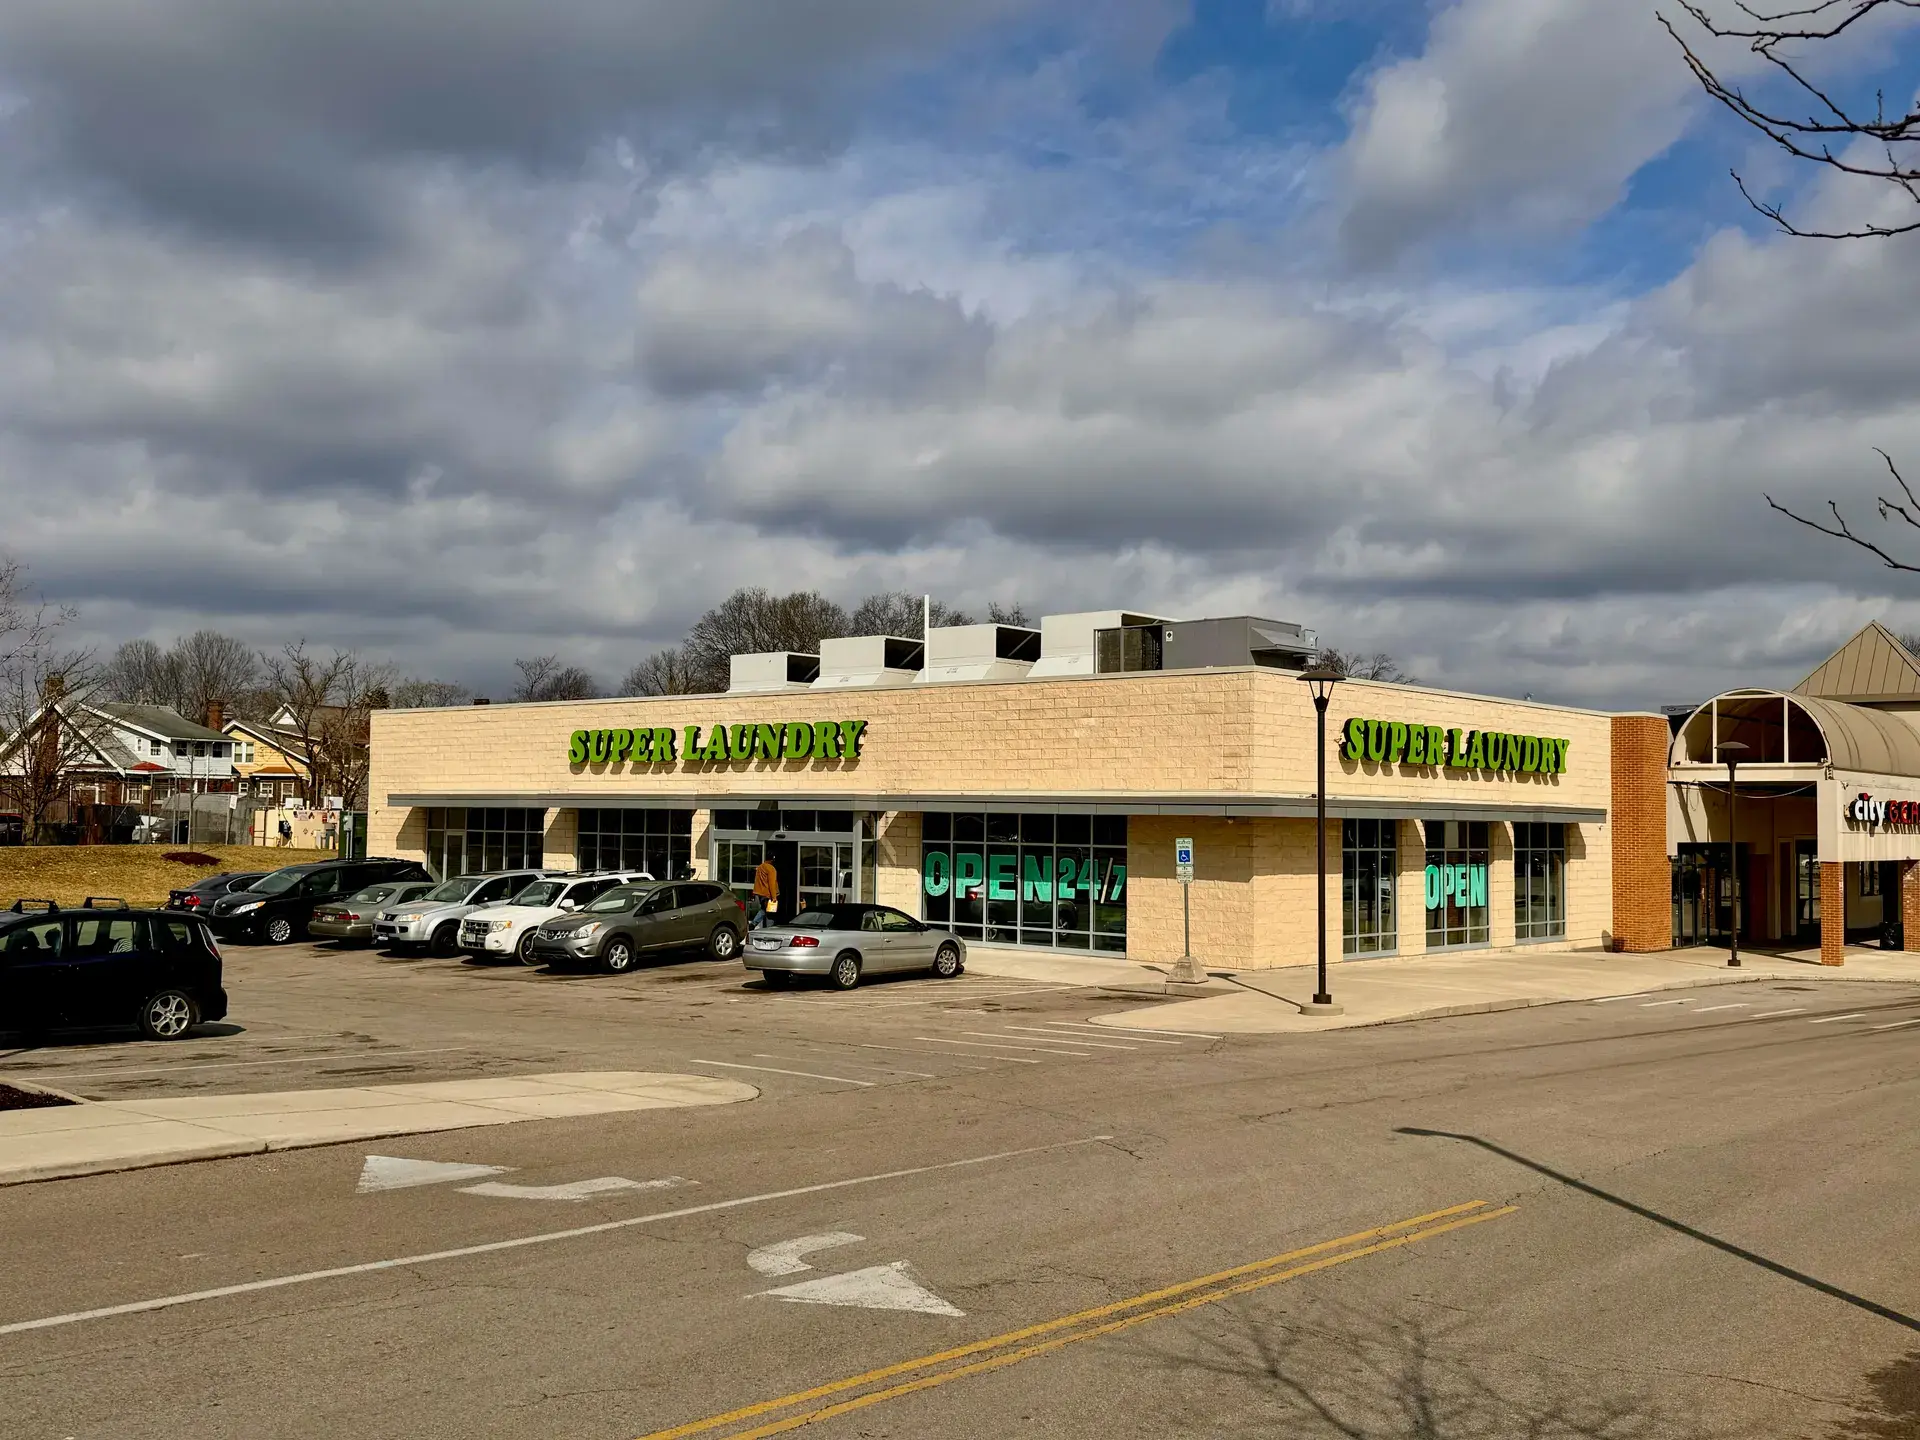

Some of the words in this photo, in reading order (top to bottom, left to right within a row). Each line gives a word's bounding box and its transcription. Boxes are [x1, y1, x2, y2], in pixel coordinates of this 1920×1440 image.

[568, 727, 677, 764] SUPER
[680, 720, 868, 761] LAUNDRY
[1344, 717, 1445, 766] SUPER
[1448, 728, 1570, 774] LAUNDRY
[924, 851, 1053, 902] OPEN
[1058, 857, 1126, 904] 24/7
[1425, 863, 1488, 910] OPEN
